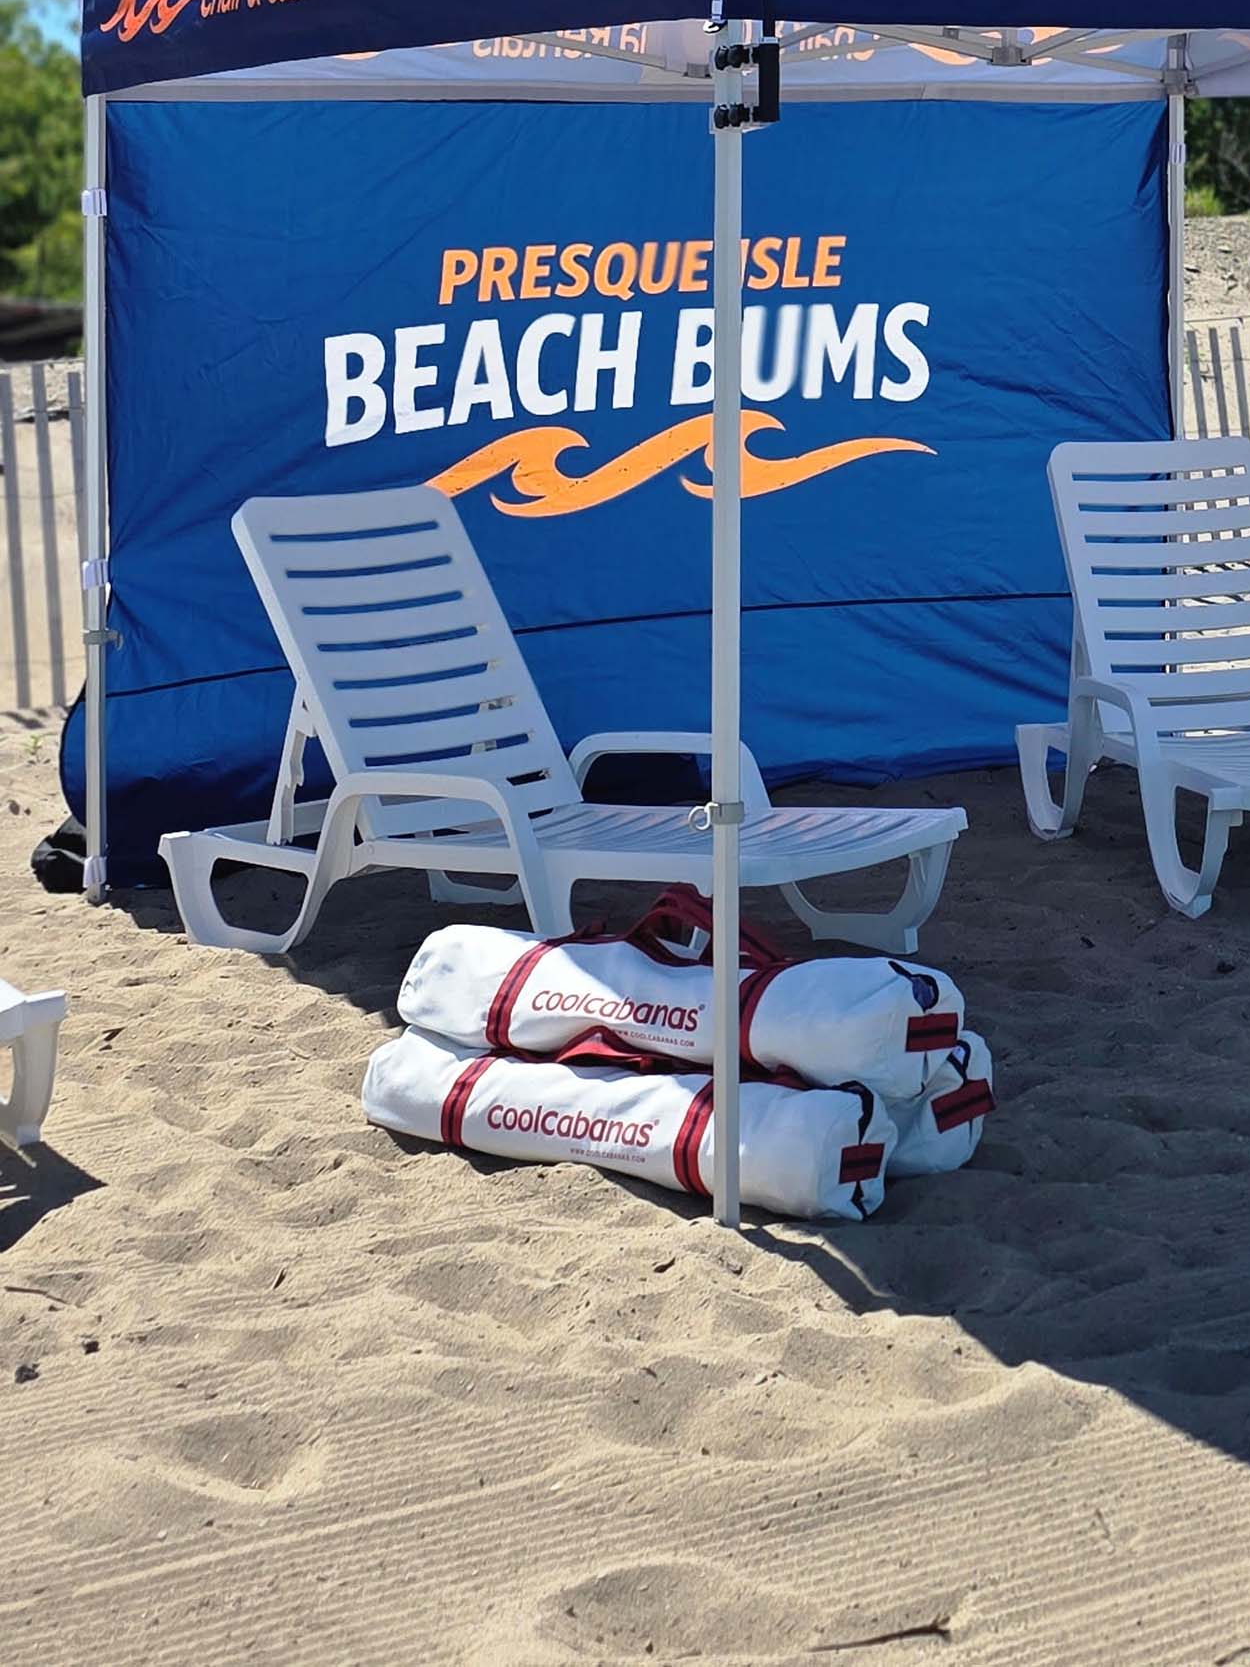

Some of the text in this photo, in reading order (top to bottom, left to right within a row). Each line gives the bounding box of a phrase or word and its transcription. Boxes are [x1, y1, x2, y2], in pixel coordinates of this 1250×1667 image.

[438, 240, 714, 305] PRESQUE
[324, 301, 930, 447] BEACH BUMS
